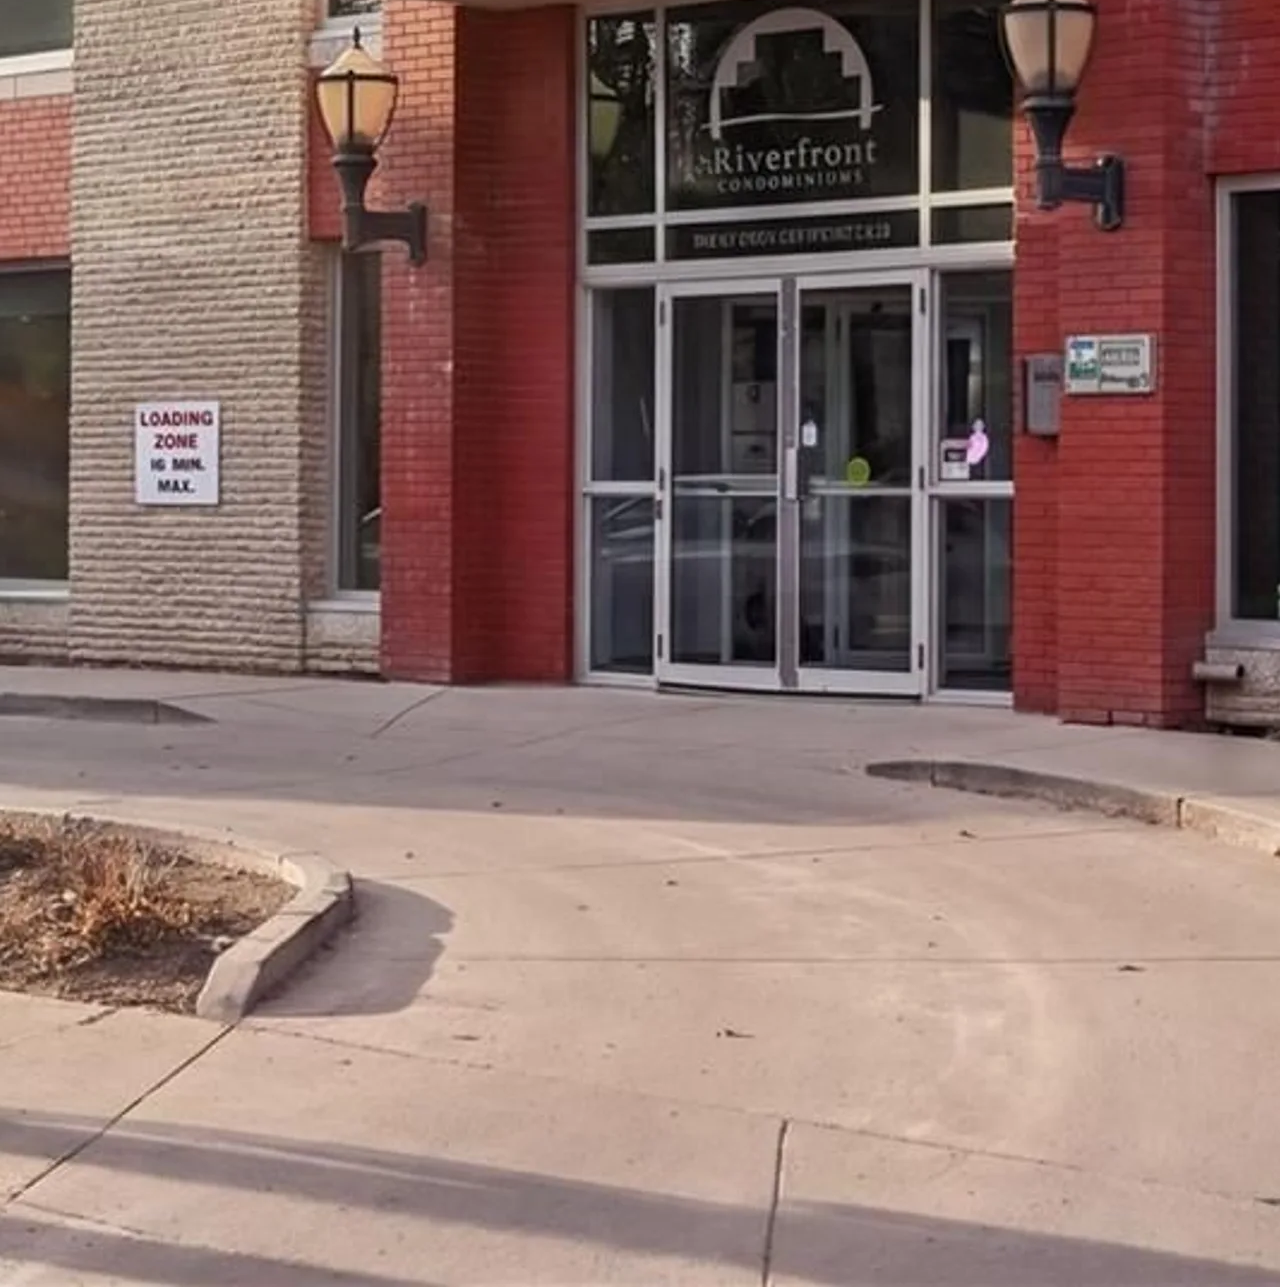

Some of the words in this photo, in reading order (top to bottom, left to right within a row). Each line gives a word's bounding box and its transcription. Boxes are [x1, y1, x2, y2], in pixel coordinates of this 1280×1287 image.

[713, 137, 877, 175] Riverfront
[717, 169, 863, 193] CONDOMINIUMS
[140, 410, 213, 427] LOADING
[154, 433, 198, 450] ZONE
[157, 479, 196, 493] MAX.
